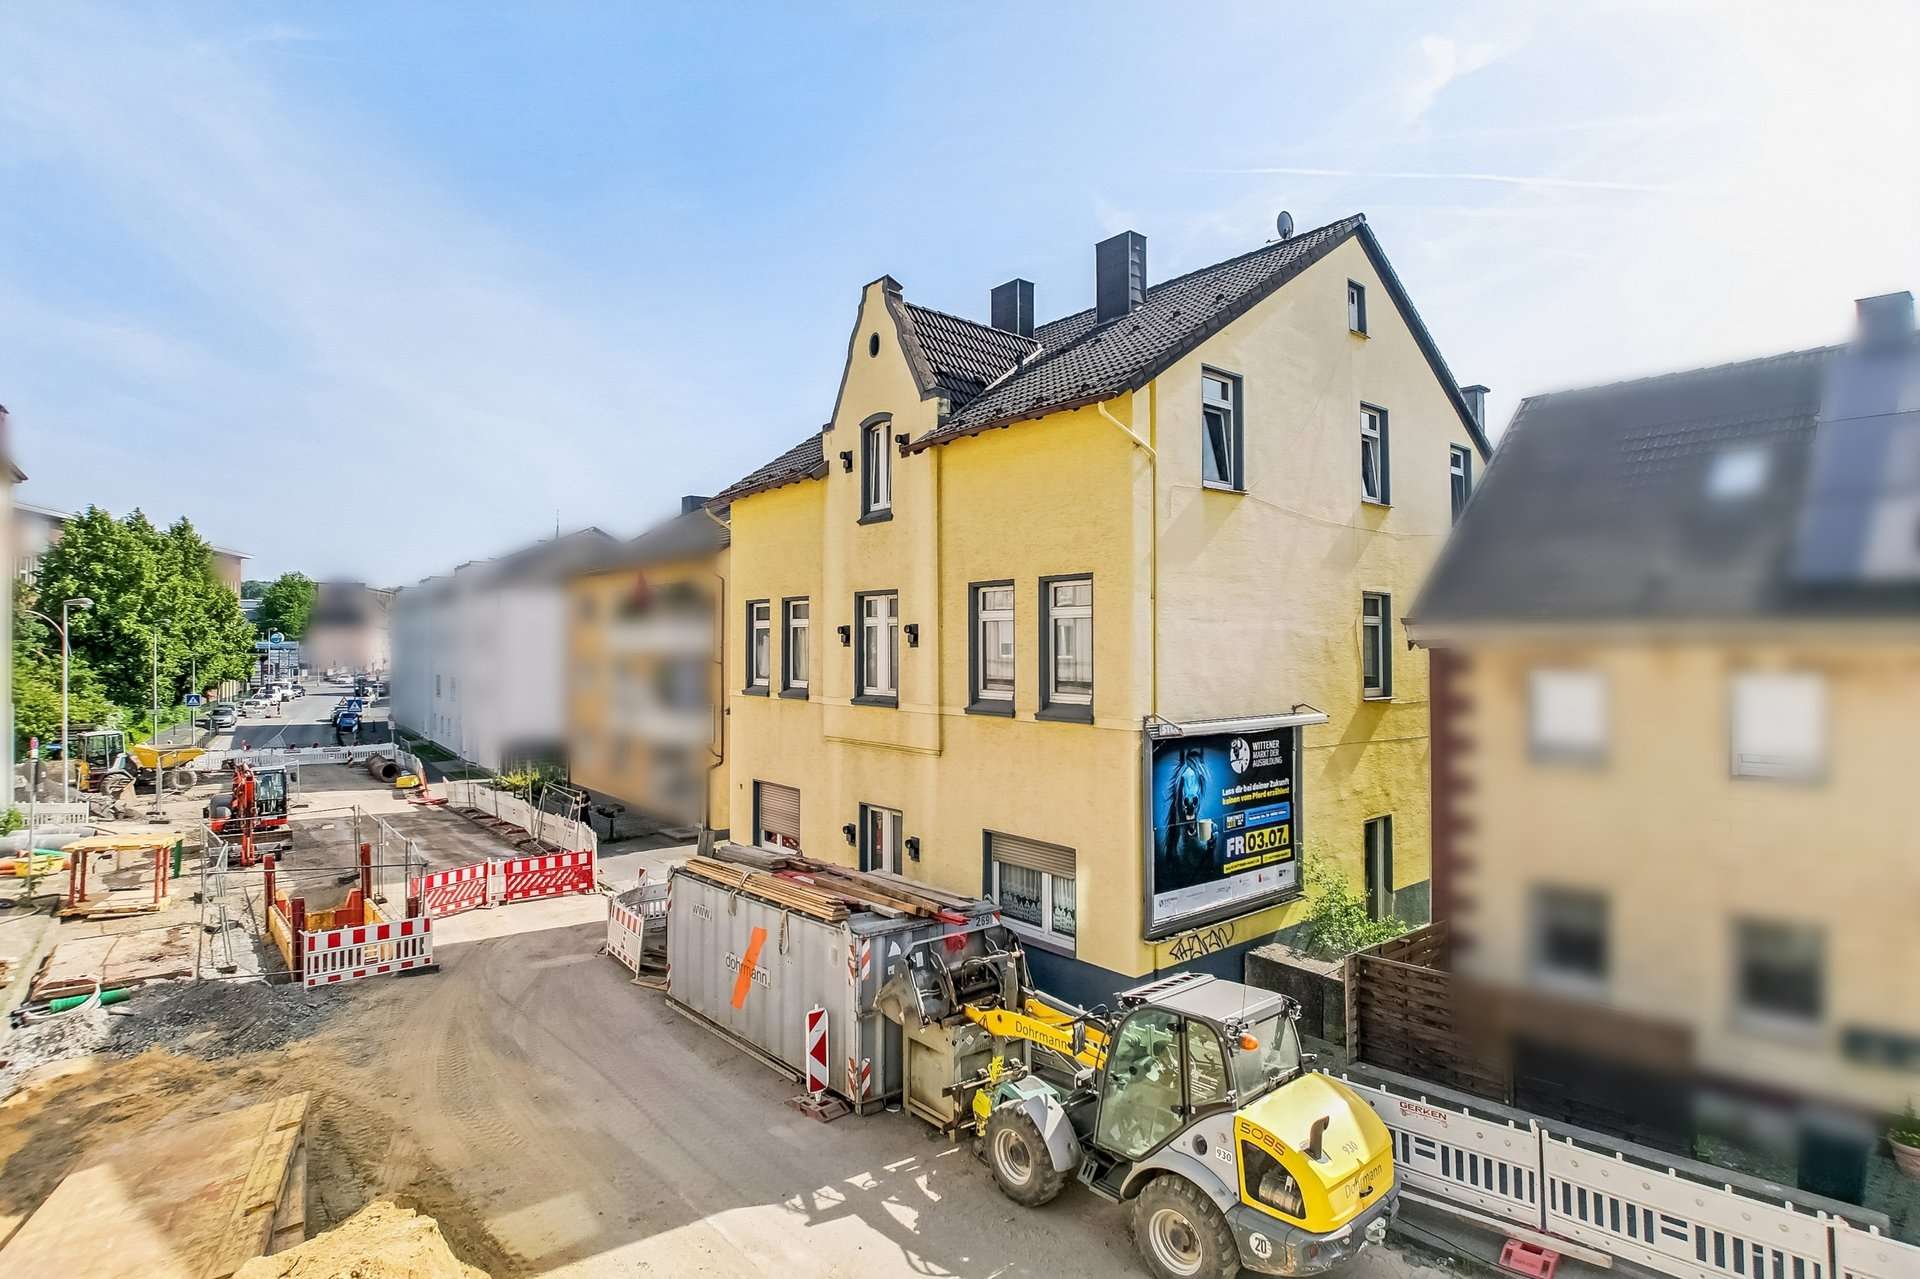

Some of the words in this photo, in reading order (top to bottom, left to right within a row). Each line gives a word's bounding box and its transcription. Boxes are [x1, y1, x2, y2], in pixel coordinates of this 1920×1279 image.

[1252, 739, 1280, 751] WITTENER
[1252, 750, 1270, 759] MARKT
[1270, 749, 1280, 757] DER
[1252, 756, 1283, 768] AUSBILDUNG
[1235, 785, 1243, 794] dir
[1243, 784, 1252, 792] bei
[1269, 777, 1290, 788] Zukunft
[1226, 836, 1245, 858] FR
[1247, 827, 1287, 851] 03.07.
[975, 913, 991, 927] 269
[1015, 1020, 1068, 1050] Dohrmann
[1399, 1101, 1447, 1120] GERKEN
[1240, 1121, 1286, 1156] 5085
[1216, 1148, 1232, 1162] 930
[1344, 1163, 1383, 1199] Dohrmann
[1254, 1236, 1267, 1254] 20
